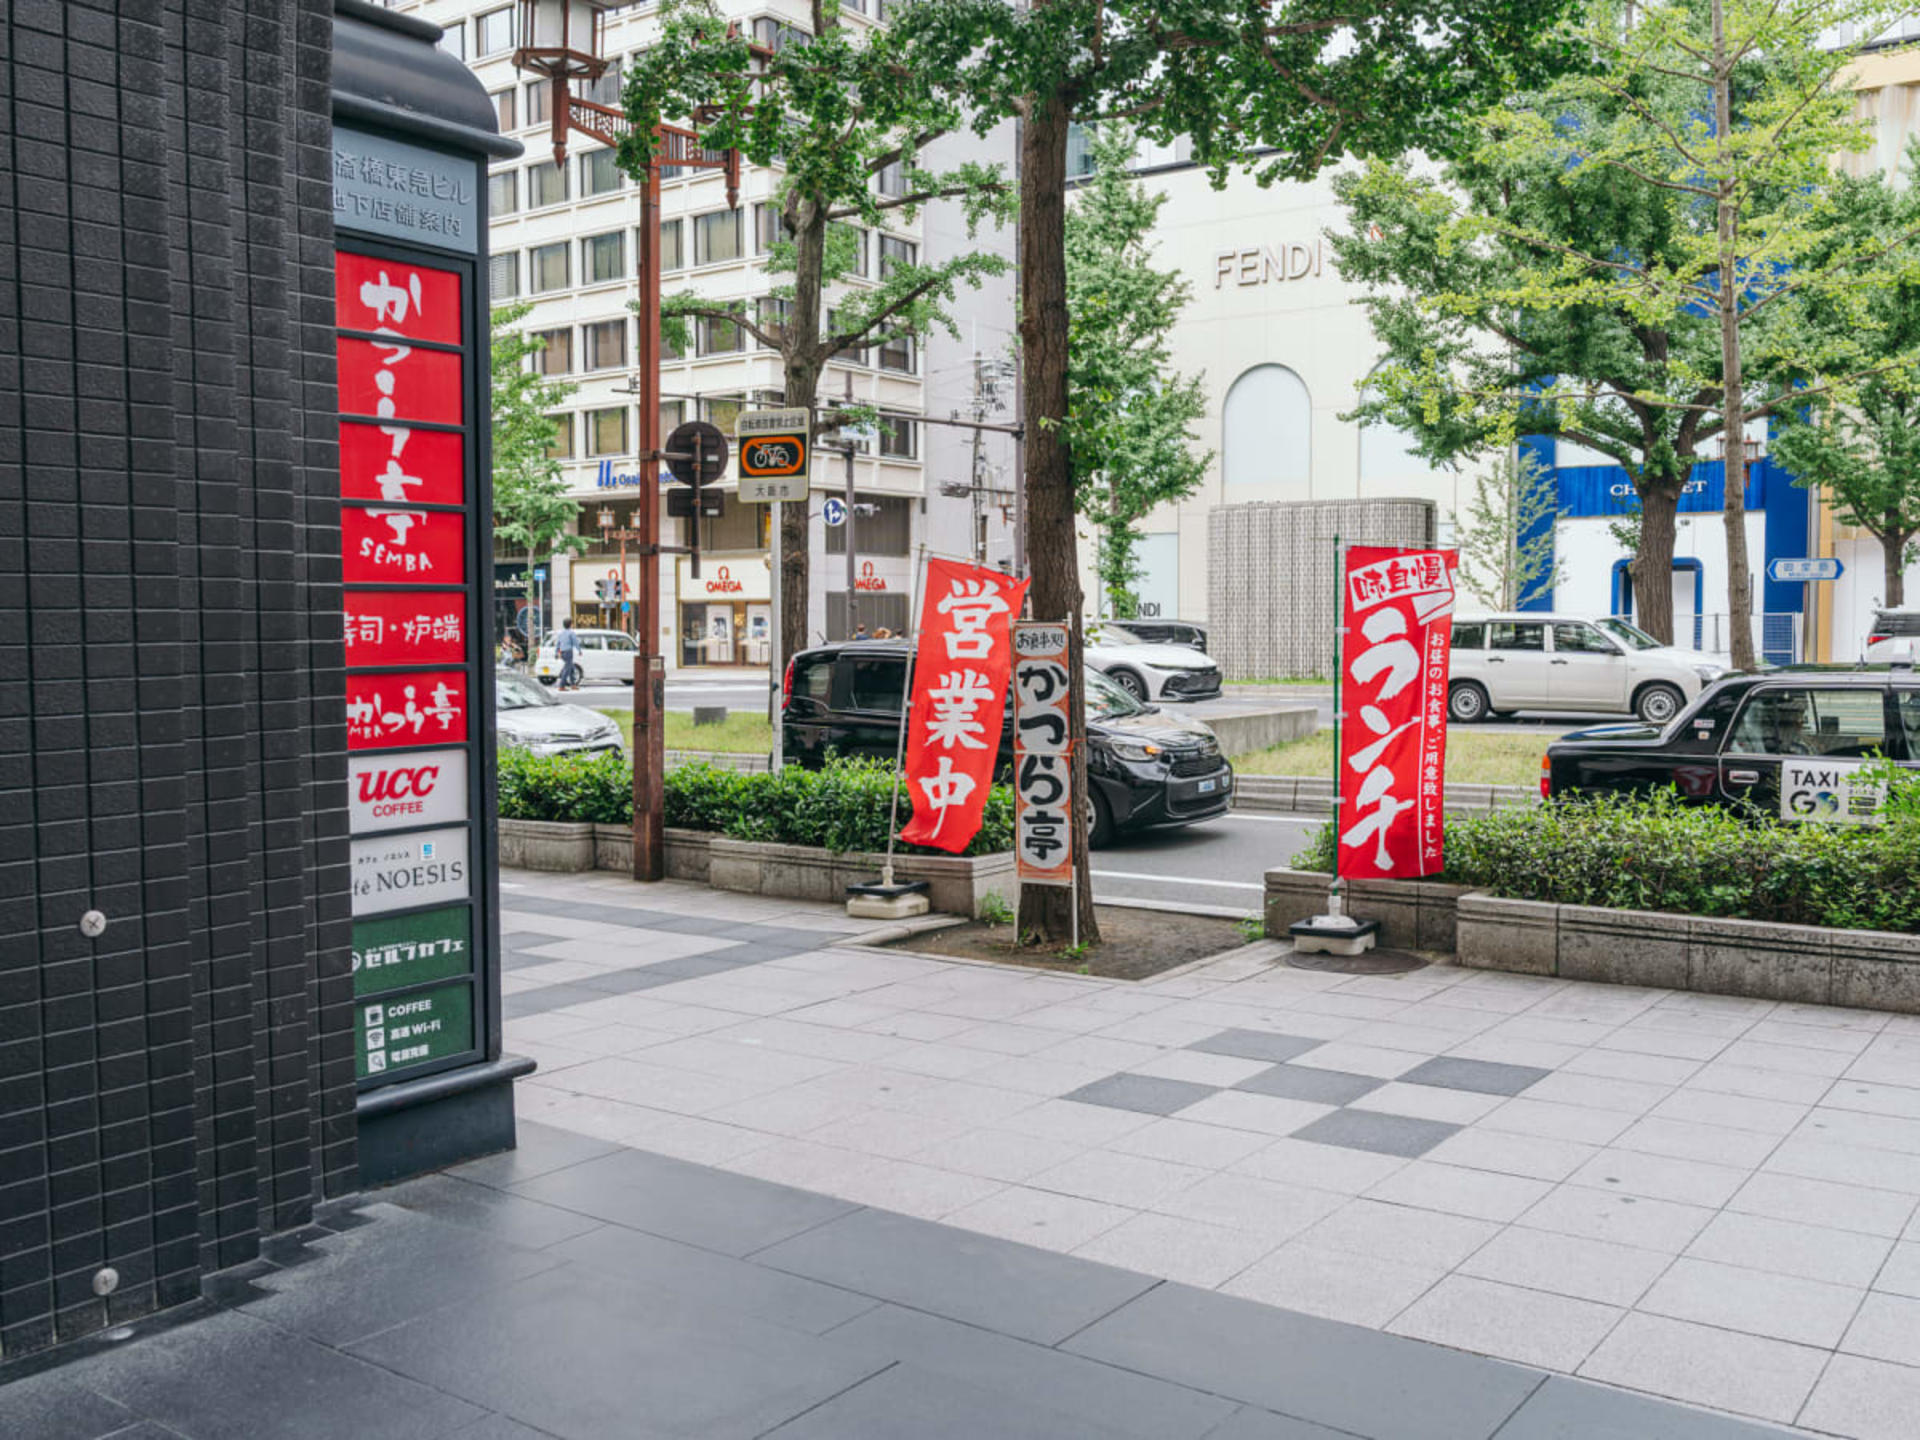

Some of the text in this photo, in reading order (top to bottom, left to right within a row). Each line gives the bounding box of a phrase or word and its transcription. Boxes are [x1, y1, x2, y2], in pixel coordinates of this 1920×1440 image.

[1214, 238, 1322, 290] FENDI
[1610, 480, 1708, 496] CHET
[360, 537, 432, 572] SEMBA
[706, 581, 743, 593] OMEGA
[1352, 556, 1442, 602] 味自慢
[1137, 602, 1161, 617] NDI
[918, 578, 1011, 839] 営業中
[1341, 606, 1422, 871] ランチ
[1017, 665, 1068, 861] かつら亭
[1790, 769, 1839, 788] TAXI
[372, 801, 424, 818] COFFEE
[376, 861, 464, 893] NOESIS
[388, 1000, 432, 1018] COFFEE
[411, 1019, 441, 1035] Wi-Fi
